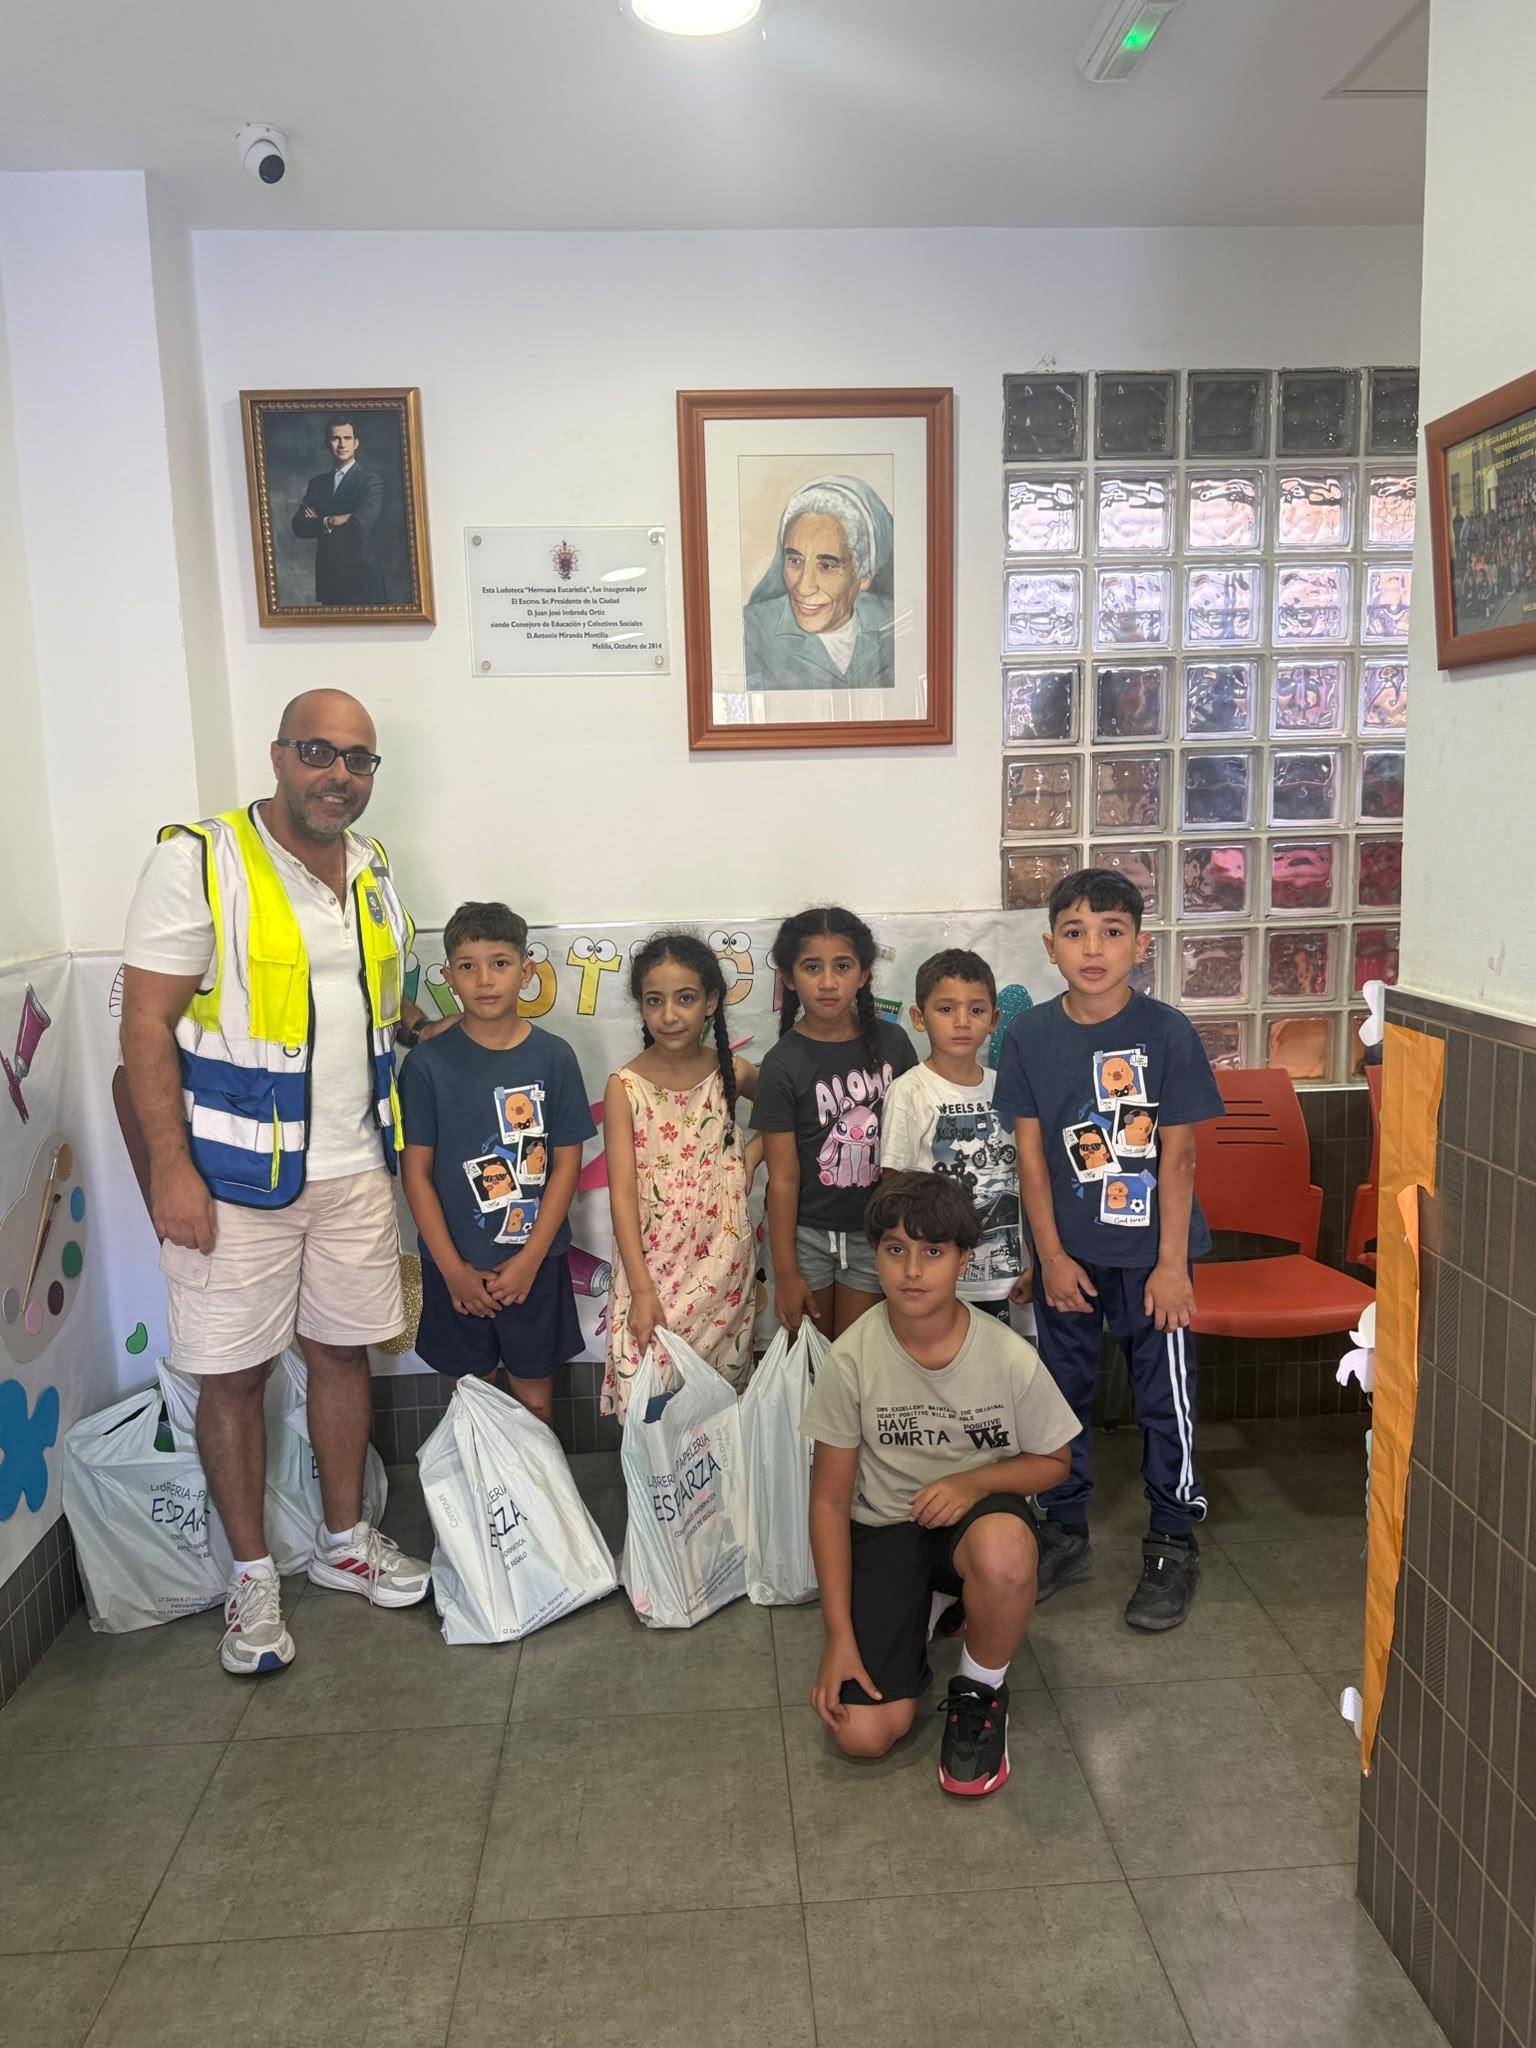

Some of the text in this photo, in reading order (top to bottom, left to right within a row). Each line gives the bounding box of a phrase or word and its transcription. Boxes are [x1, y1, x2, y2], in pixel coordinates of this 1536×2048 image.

[1510, 426, 1517, 435] DE
[1505, 458, 1512, 466] DE
[1512, 455, 1519, 463] SU
[1519, 448, 1534, 460] VISITA
[603, 586, 636, 594] inaugurada
[534, 609, 548, 617] Juan
[510, 621, 541, 629] Consejero
[976, 1103, 986, 1112] &
[899, 1410, 929, 1418] POSITIVE
[975, 1404, 1006, 1414] ORIGINAL
[877, 1416, 919, 1431] HAVE
[963, 1418, 1002, 1430] POSITIVE
[879, 1429, 951, 1446] OMRTA
[653, 1451, 722, 1521] ESPARZA
[510, 1551, 528, 1568] REGALO
